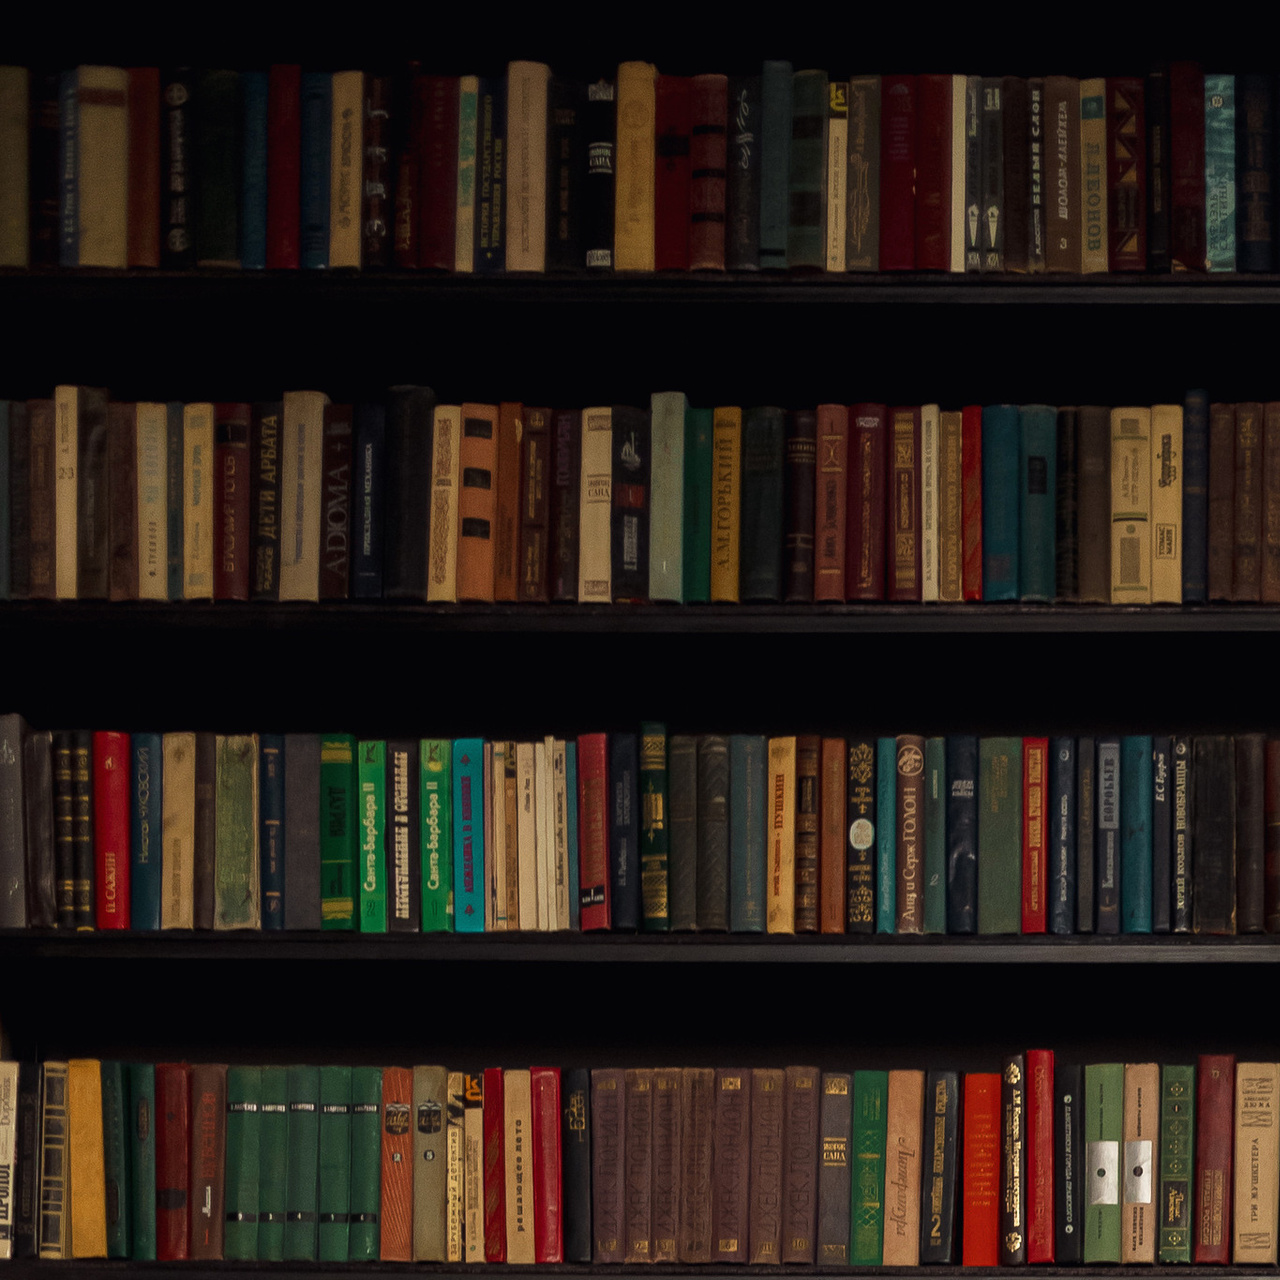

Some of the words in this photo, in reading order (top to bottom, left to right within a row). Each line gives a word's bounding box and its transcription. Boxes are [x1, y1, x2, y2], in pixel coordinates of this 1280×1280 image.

[1031, 90, 1041, 136] СЛОН
[259, 415, 278, 483] АРБАТА
[259, 490, 277, 539] ДЕТИ
[902, 787, 917, 841] ГОЛОН
[1175, 760, 1187, 830] НОВОБРАНЦЫ
[902, 843, 918, 880] Серж
[447, 1131, 458, 1186] детектив
[515, 1154, 524, 1232] решающее
[1250, 1202, 1260, 1222] ТРИ
[448, 1189, 460, 1256] зарубежный
